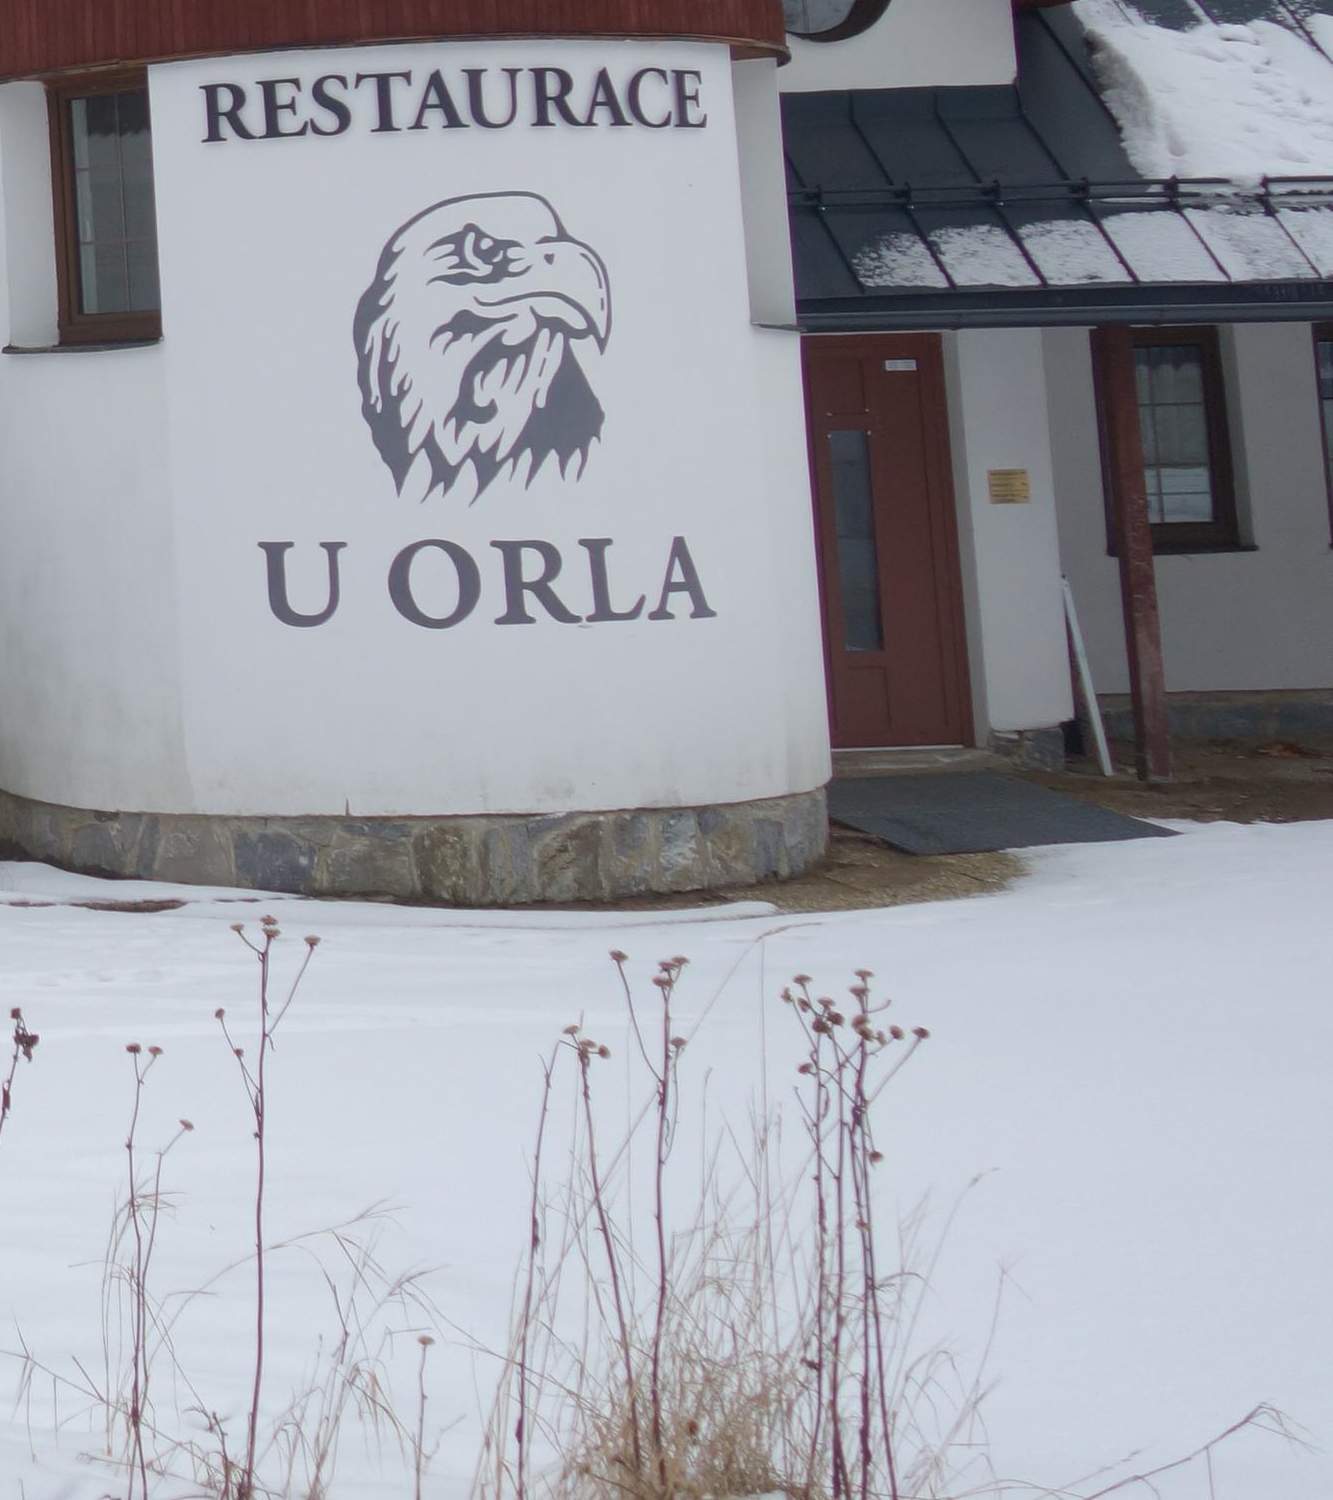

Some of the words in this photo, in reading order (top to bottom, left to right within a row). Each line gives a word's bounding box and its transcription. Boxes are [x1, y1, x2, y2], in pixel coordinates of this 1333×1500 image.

[199, 67, 708, 143] RESTAURACE
[258, 541, 347, 628] U
[387, 535, 717, 629] ORLA
